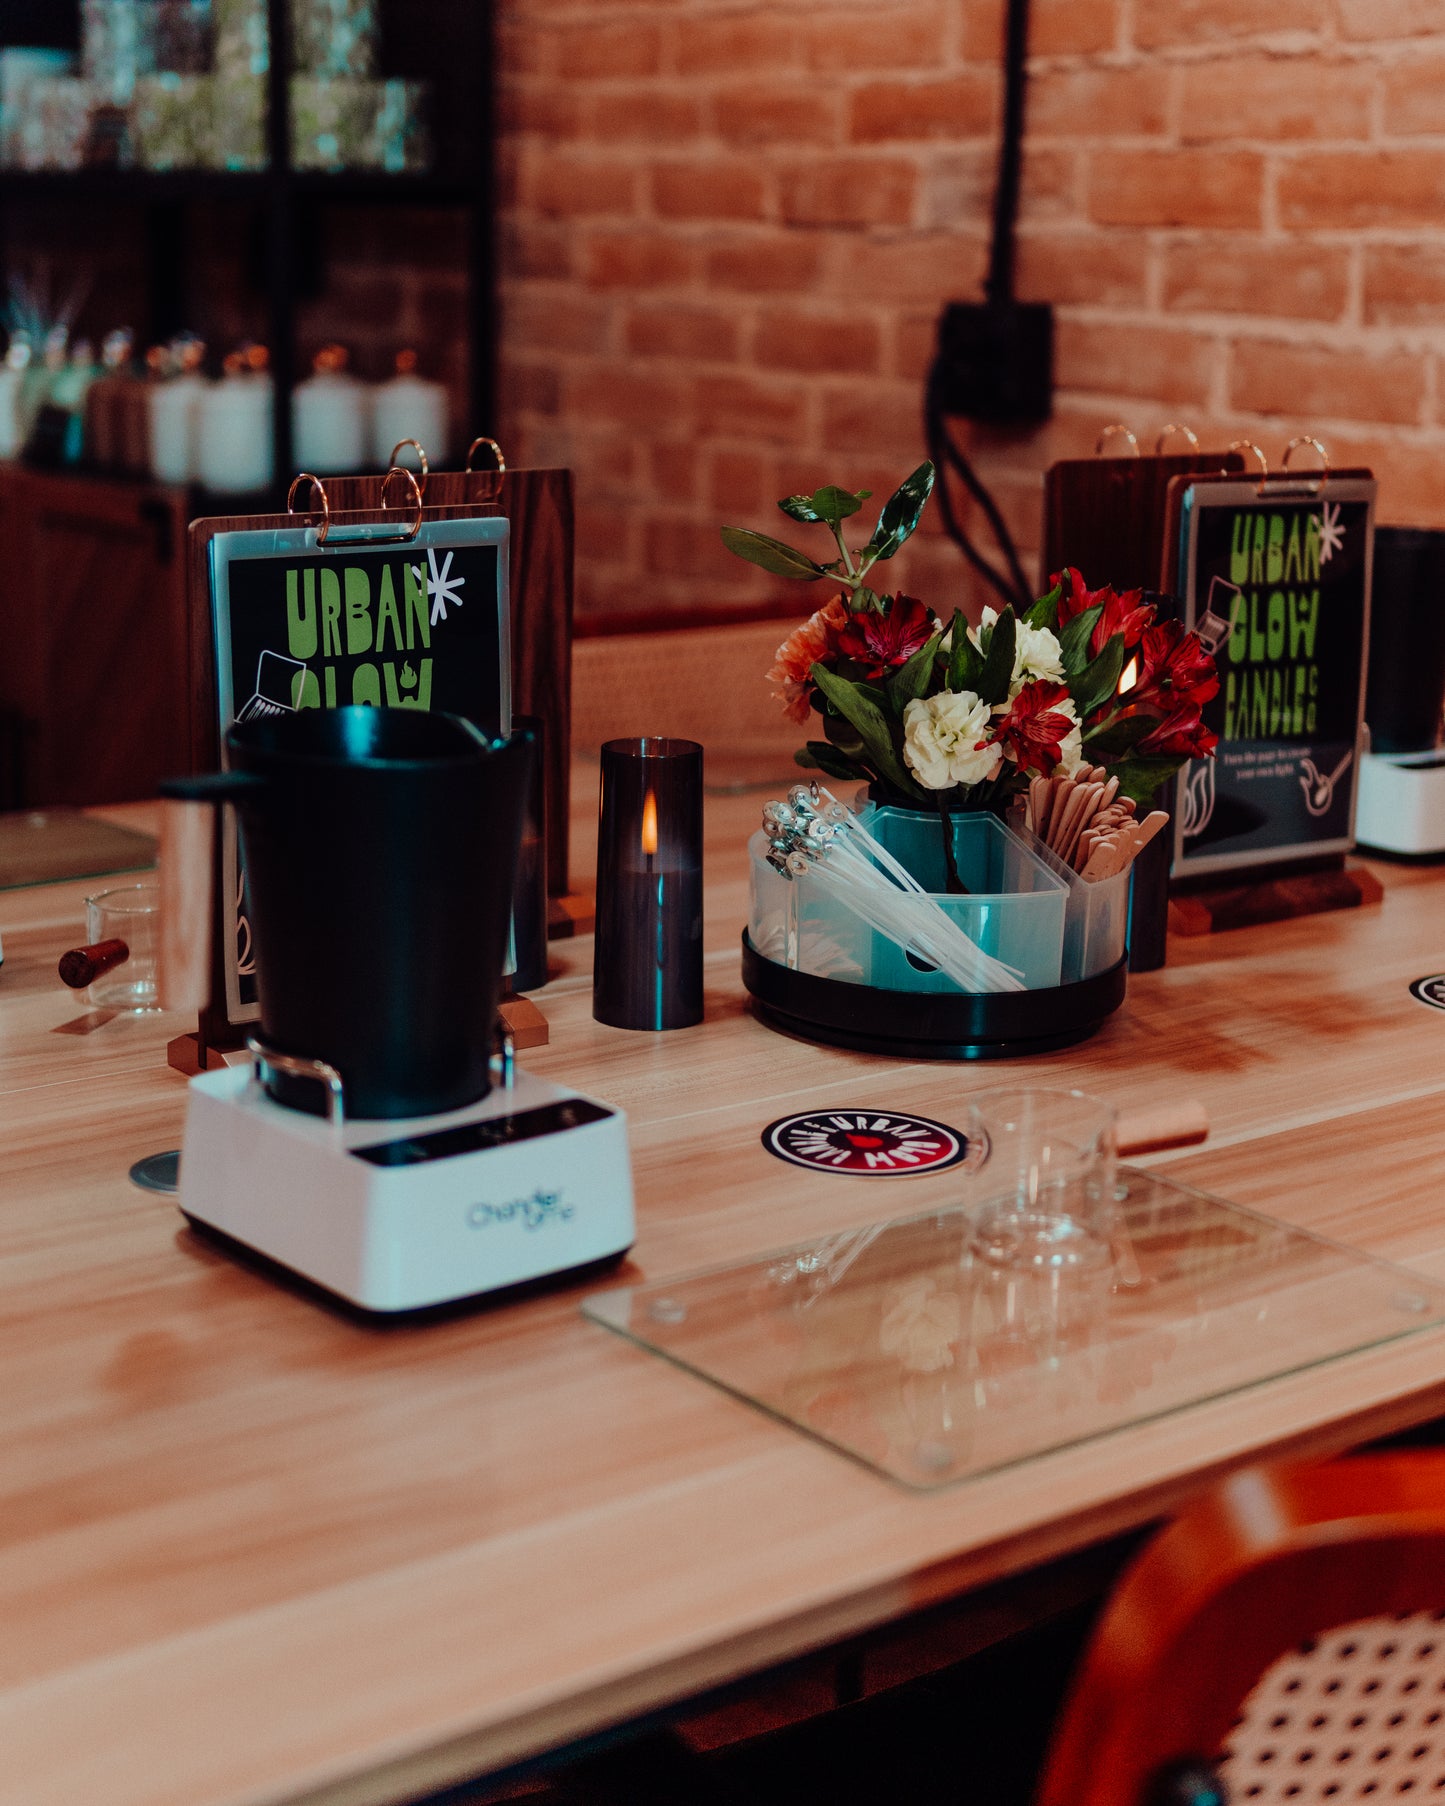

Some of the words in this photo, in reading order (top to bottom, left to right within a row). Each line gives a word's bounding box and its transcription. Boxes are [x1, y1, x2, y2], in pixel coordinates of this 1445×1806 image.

[1230, 513, 1320, 585] URBAN
[286, 562, 431, 659] URBAN
[1229, 590, 1319, 663] GLOW
[829, 1116, 931, 1138] URBAN
[864, 1140, 941, 1168] GLOW
